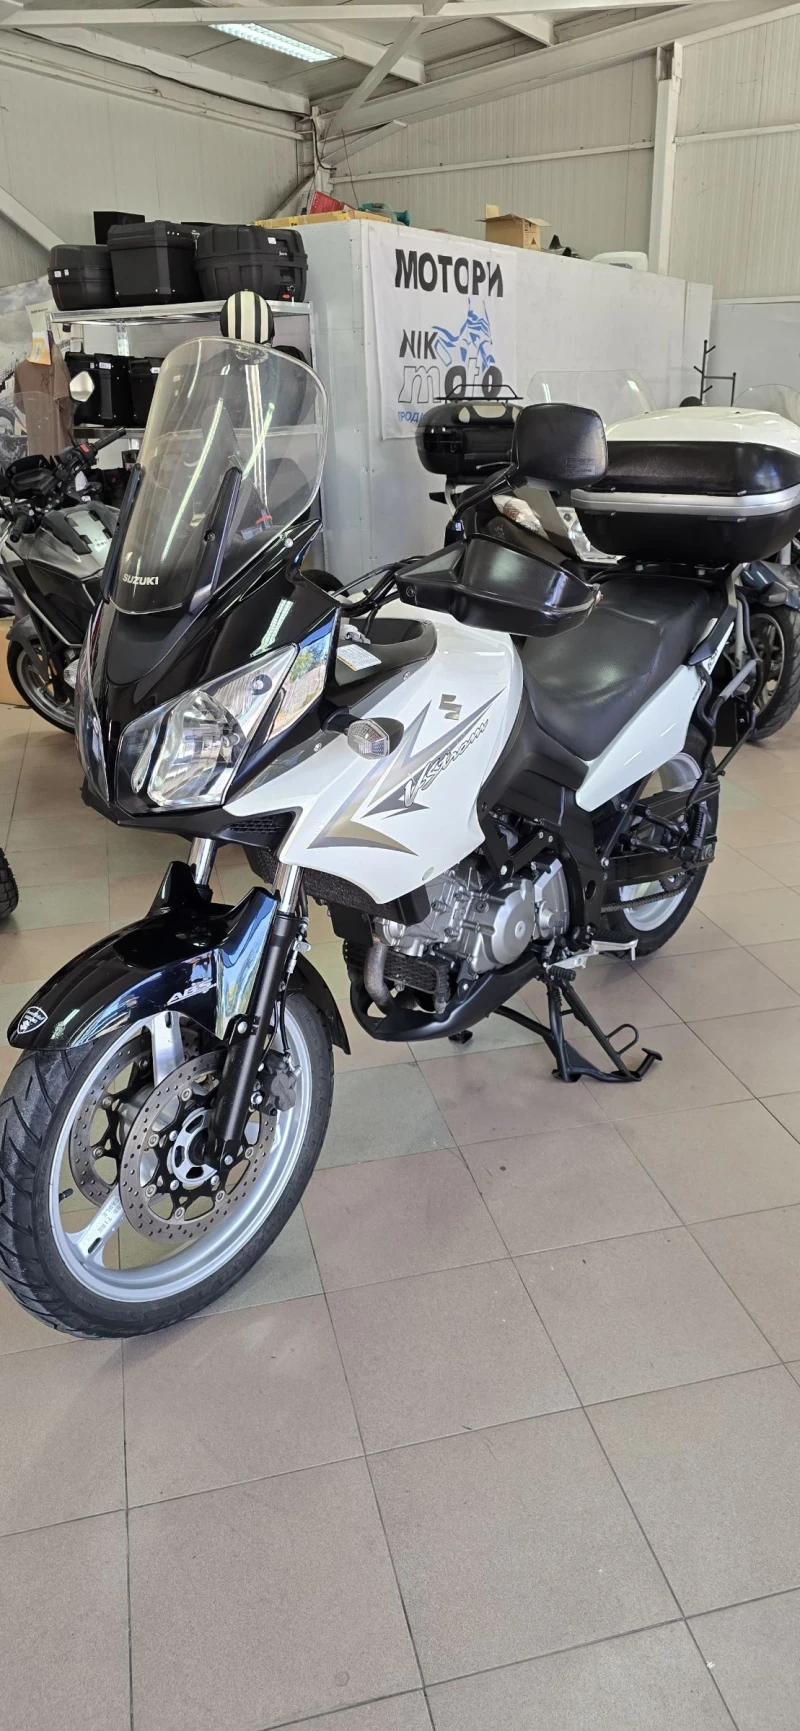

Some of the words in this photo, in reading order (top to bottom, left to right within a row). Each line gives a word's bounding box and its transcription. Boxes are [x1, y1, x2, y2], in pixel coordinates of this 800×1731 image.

[395, 248, 504, 298] МОТОРИ
[399, 328, 438, 360] NIK
[122, 573, 159, 586] SUZUKI
